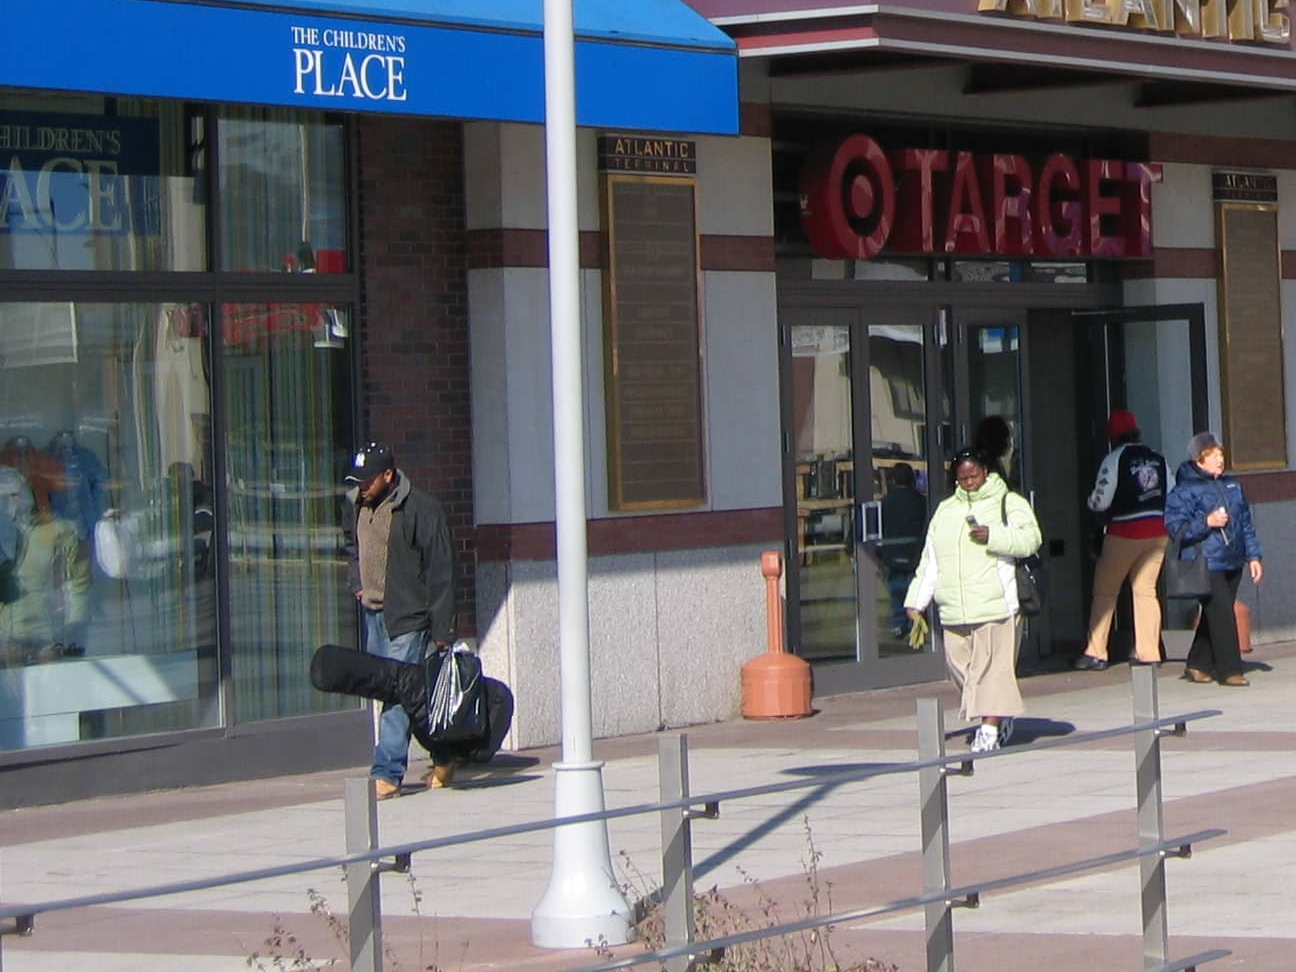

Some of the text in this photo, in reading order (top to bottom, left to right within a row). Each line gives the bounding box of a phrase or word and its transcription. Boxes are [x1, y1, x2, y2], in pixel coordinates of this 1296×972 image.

[291, 26, 407, 53] THE CHILDREN'S
[293, 48, 408, 101] PLACE
[615, 139, 689, 158] ATLANTIC
[905, 148, 1164, 257] TARGET
